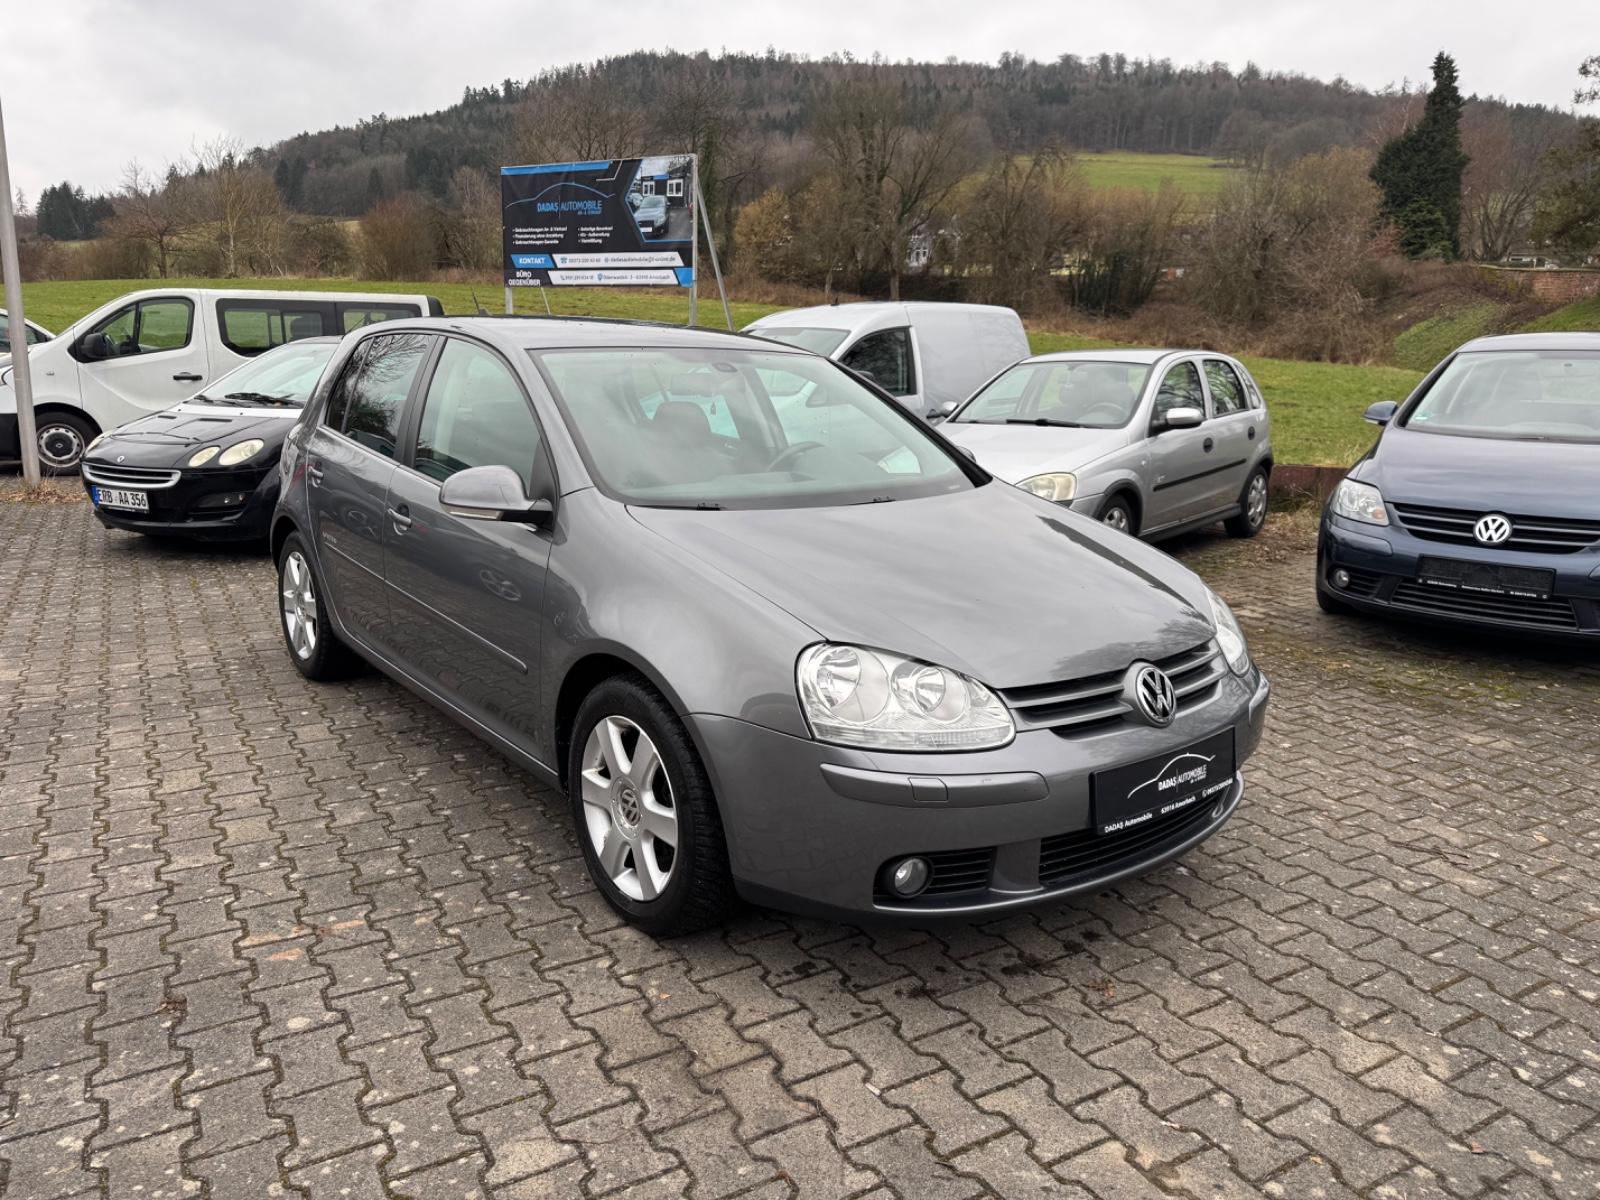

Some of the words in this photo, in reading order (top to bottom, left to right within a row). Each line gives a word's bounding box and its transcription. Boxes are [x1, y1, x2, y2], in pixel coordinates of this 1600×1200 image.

[560, 200, 602, 212] AUTOMOBILE
[516, 270, 532, 278] BÜRO
[508, 277, 541, 286] GEGENÜBER
[97, 489, 113, 503] ERB
[118, 491, 130, 505] AA
[130, 493, 147, 507] 356
[1177, 764, 1207, 784] AUTOMOBILE
[1124, 812, 1153, 828] Automobile
